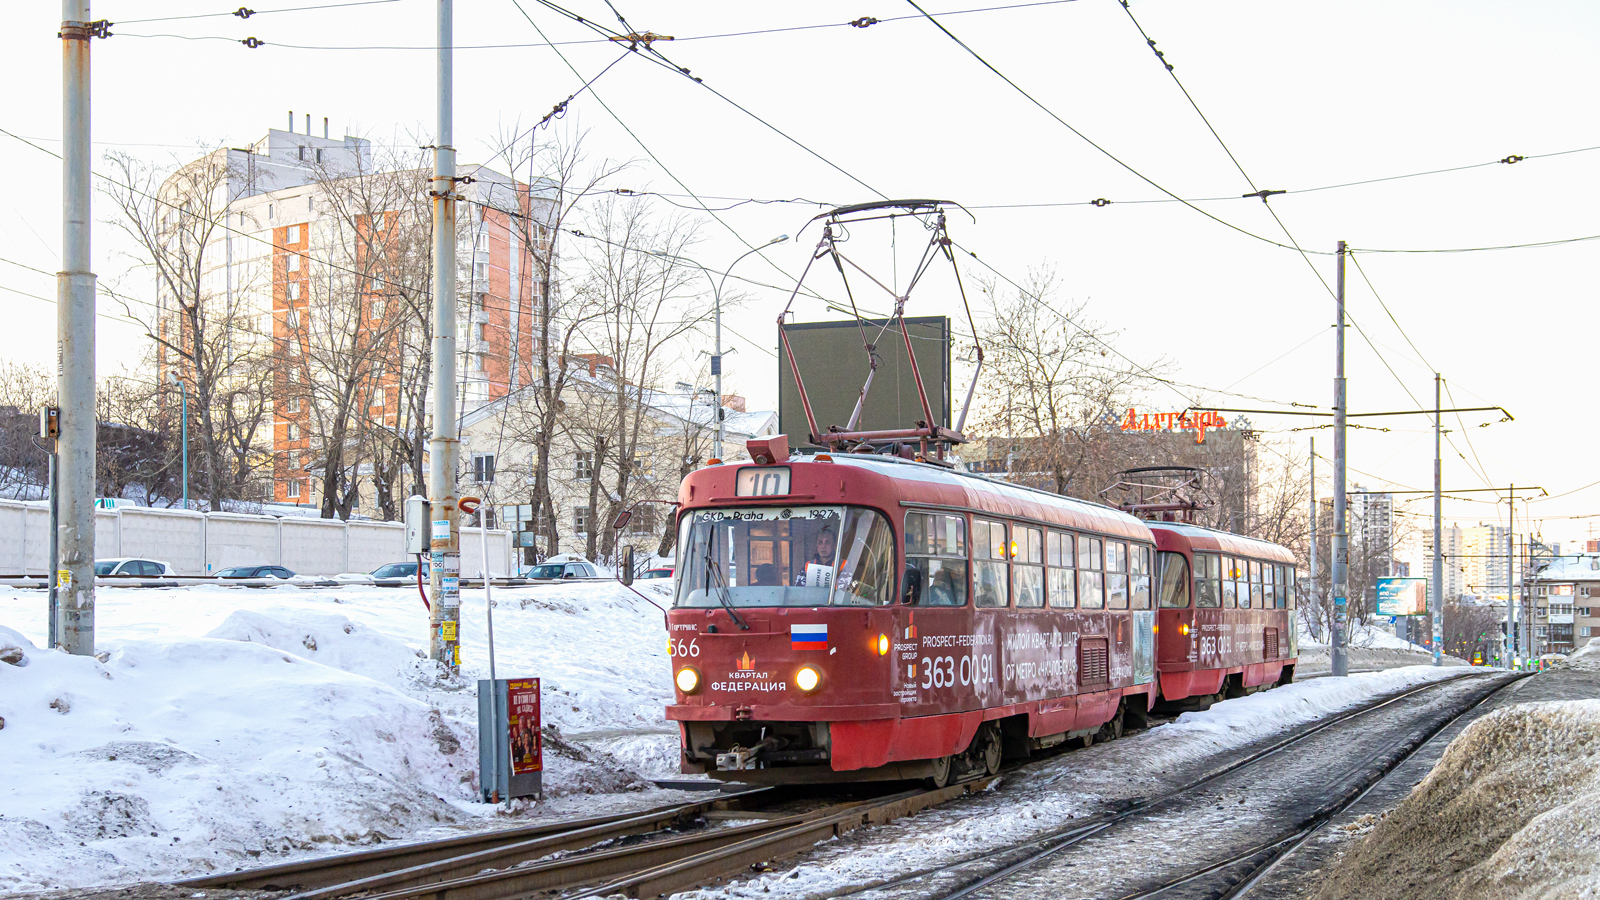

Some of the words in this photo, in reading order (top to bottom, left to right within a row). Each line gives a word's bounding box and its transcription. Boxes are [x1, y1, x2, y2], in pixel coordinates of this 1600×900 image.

[750, 473, 781, 496] 10
[671, 638, 700, 658] 566
[894, 643, 918, 651] PROSPECT
[1006, 630, 1030, 650] ЖИЛОЙ
[1201, 636, 1217, 655] 363
[902, 652, 918, 660] GROUP
[921, 656, 955, 690] 363
[1005, 664, 1015, 681] ОТ
[1016, 661, 1037, 680] МЕТРО
[711, 681, 787, 693] ФЕДЕРАЦИЯ
